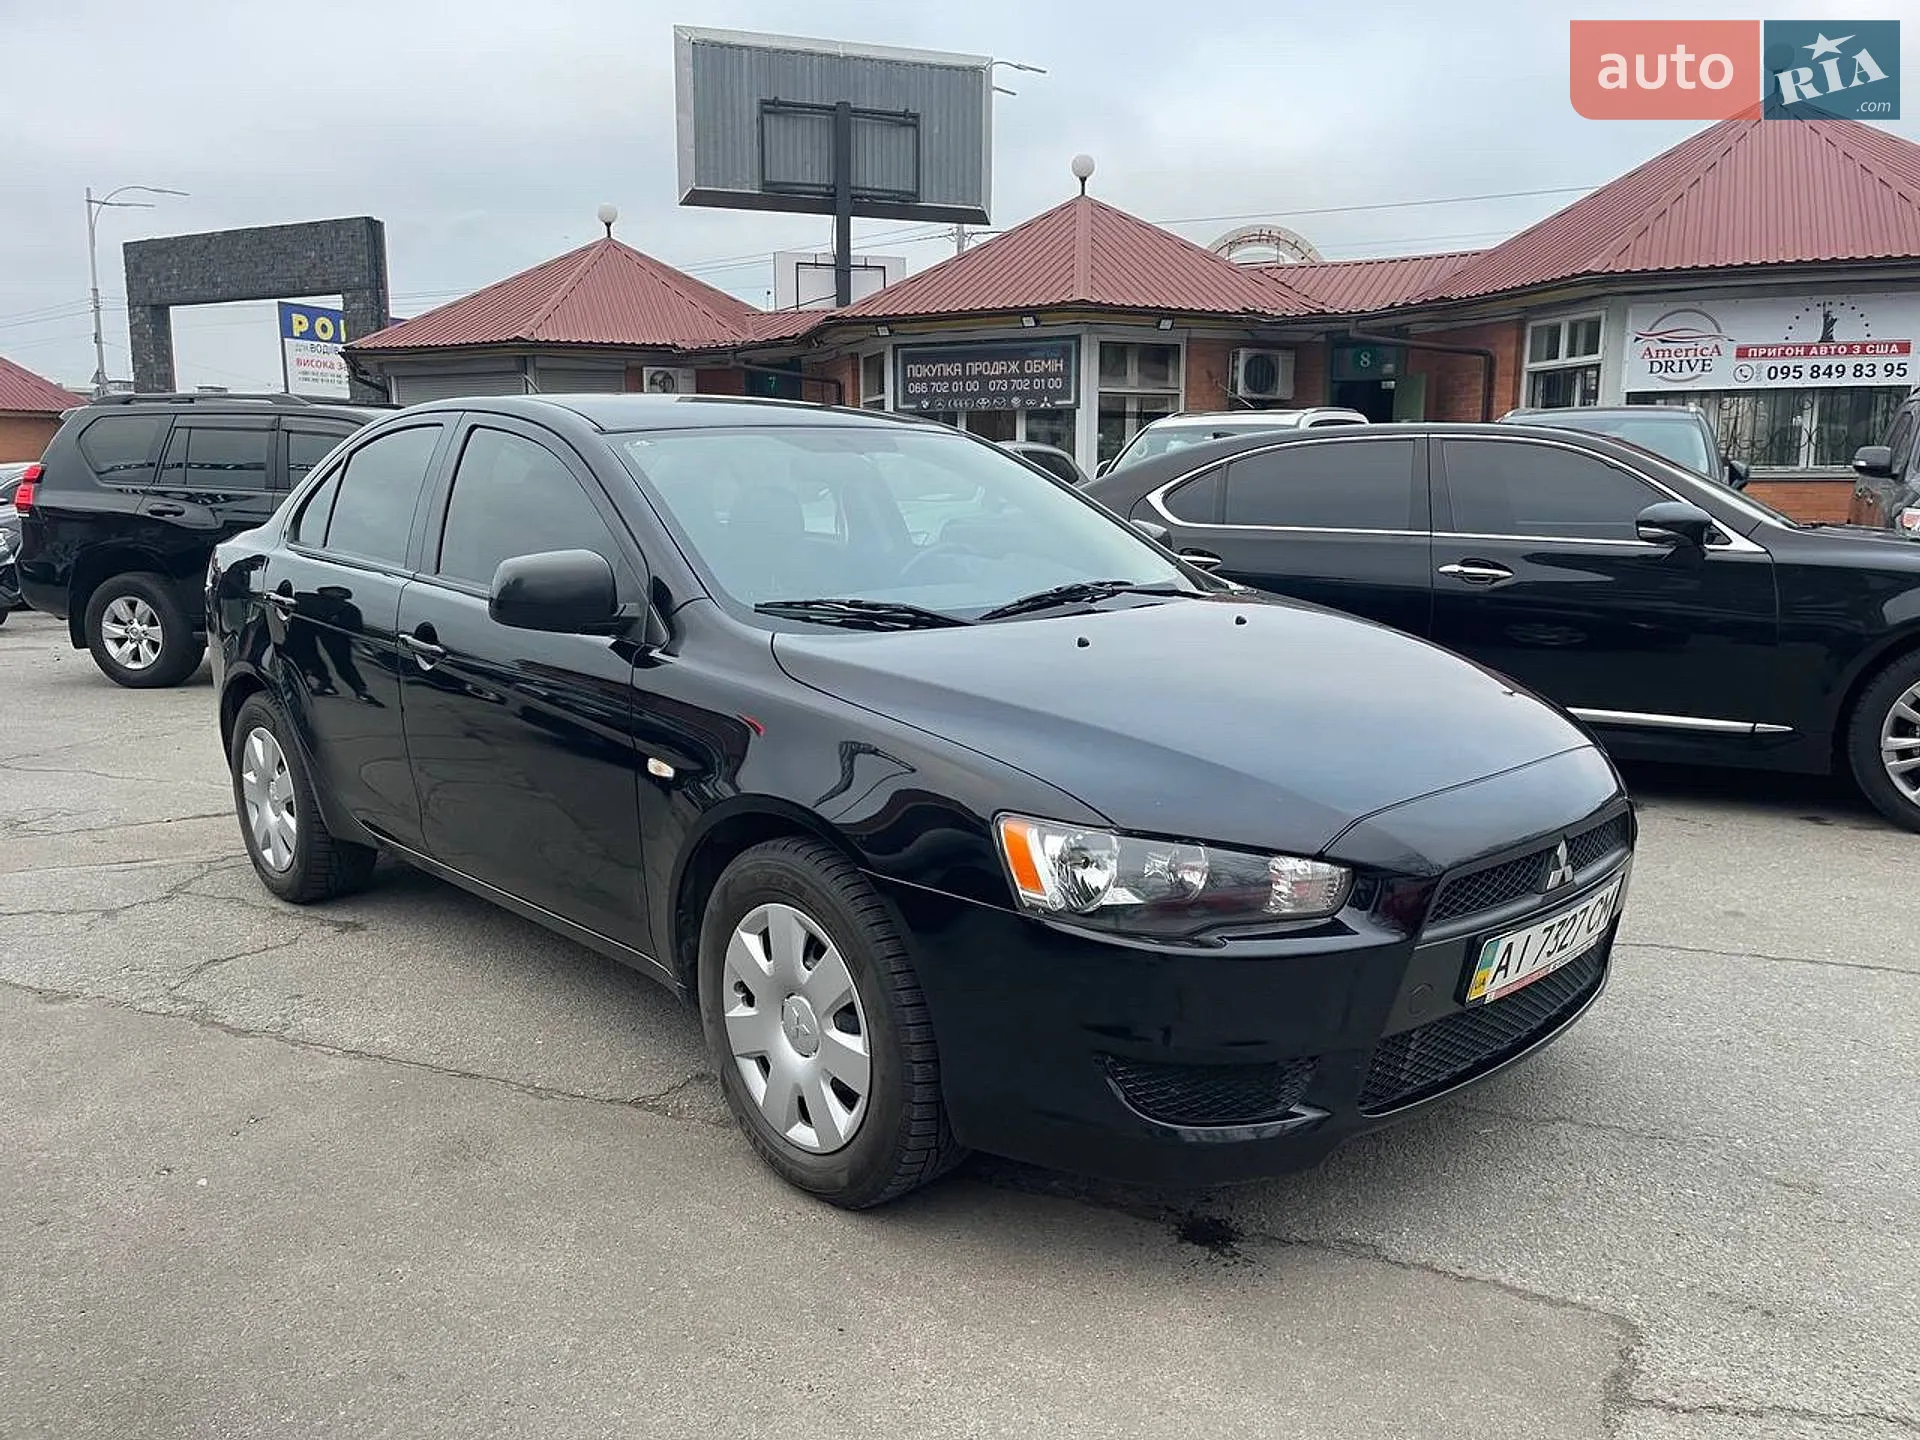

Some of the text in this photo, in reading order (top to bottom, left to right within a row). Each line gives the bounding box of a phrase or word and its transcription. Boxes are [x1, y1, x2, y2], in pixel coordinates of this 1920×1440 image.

[1748, 346, 1804, 357] ПРИГОН
[1810, 344, 1847, 356] АВТО
[1866, 343, 1899, 354] США
[1360, 351, 1371, 367] 8
[1649, 359, 1713, 374] DRIVE
[907, 358, 1064, 378] ПОКУПКА ПРОДАЖ ОБМІН
[1767, 362, 1908, 380] 095 849 83 95
[930, 380, 949, 393] 702
[952, 380, 963, 392] 01
[965, 379, 979, 392] 00
[988, 379, 1008, 392] 073
[1010, 378, 1030, 390] 702
[1033, 378, 1045, 390] 01
[1047, 377, 1062, 389] 00
[1490, 934, 1531, 985] AI
[1532, 904, 1590, 966] 7327
[1586, 885, 1618, 934] CM
